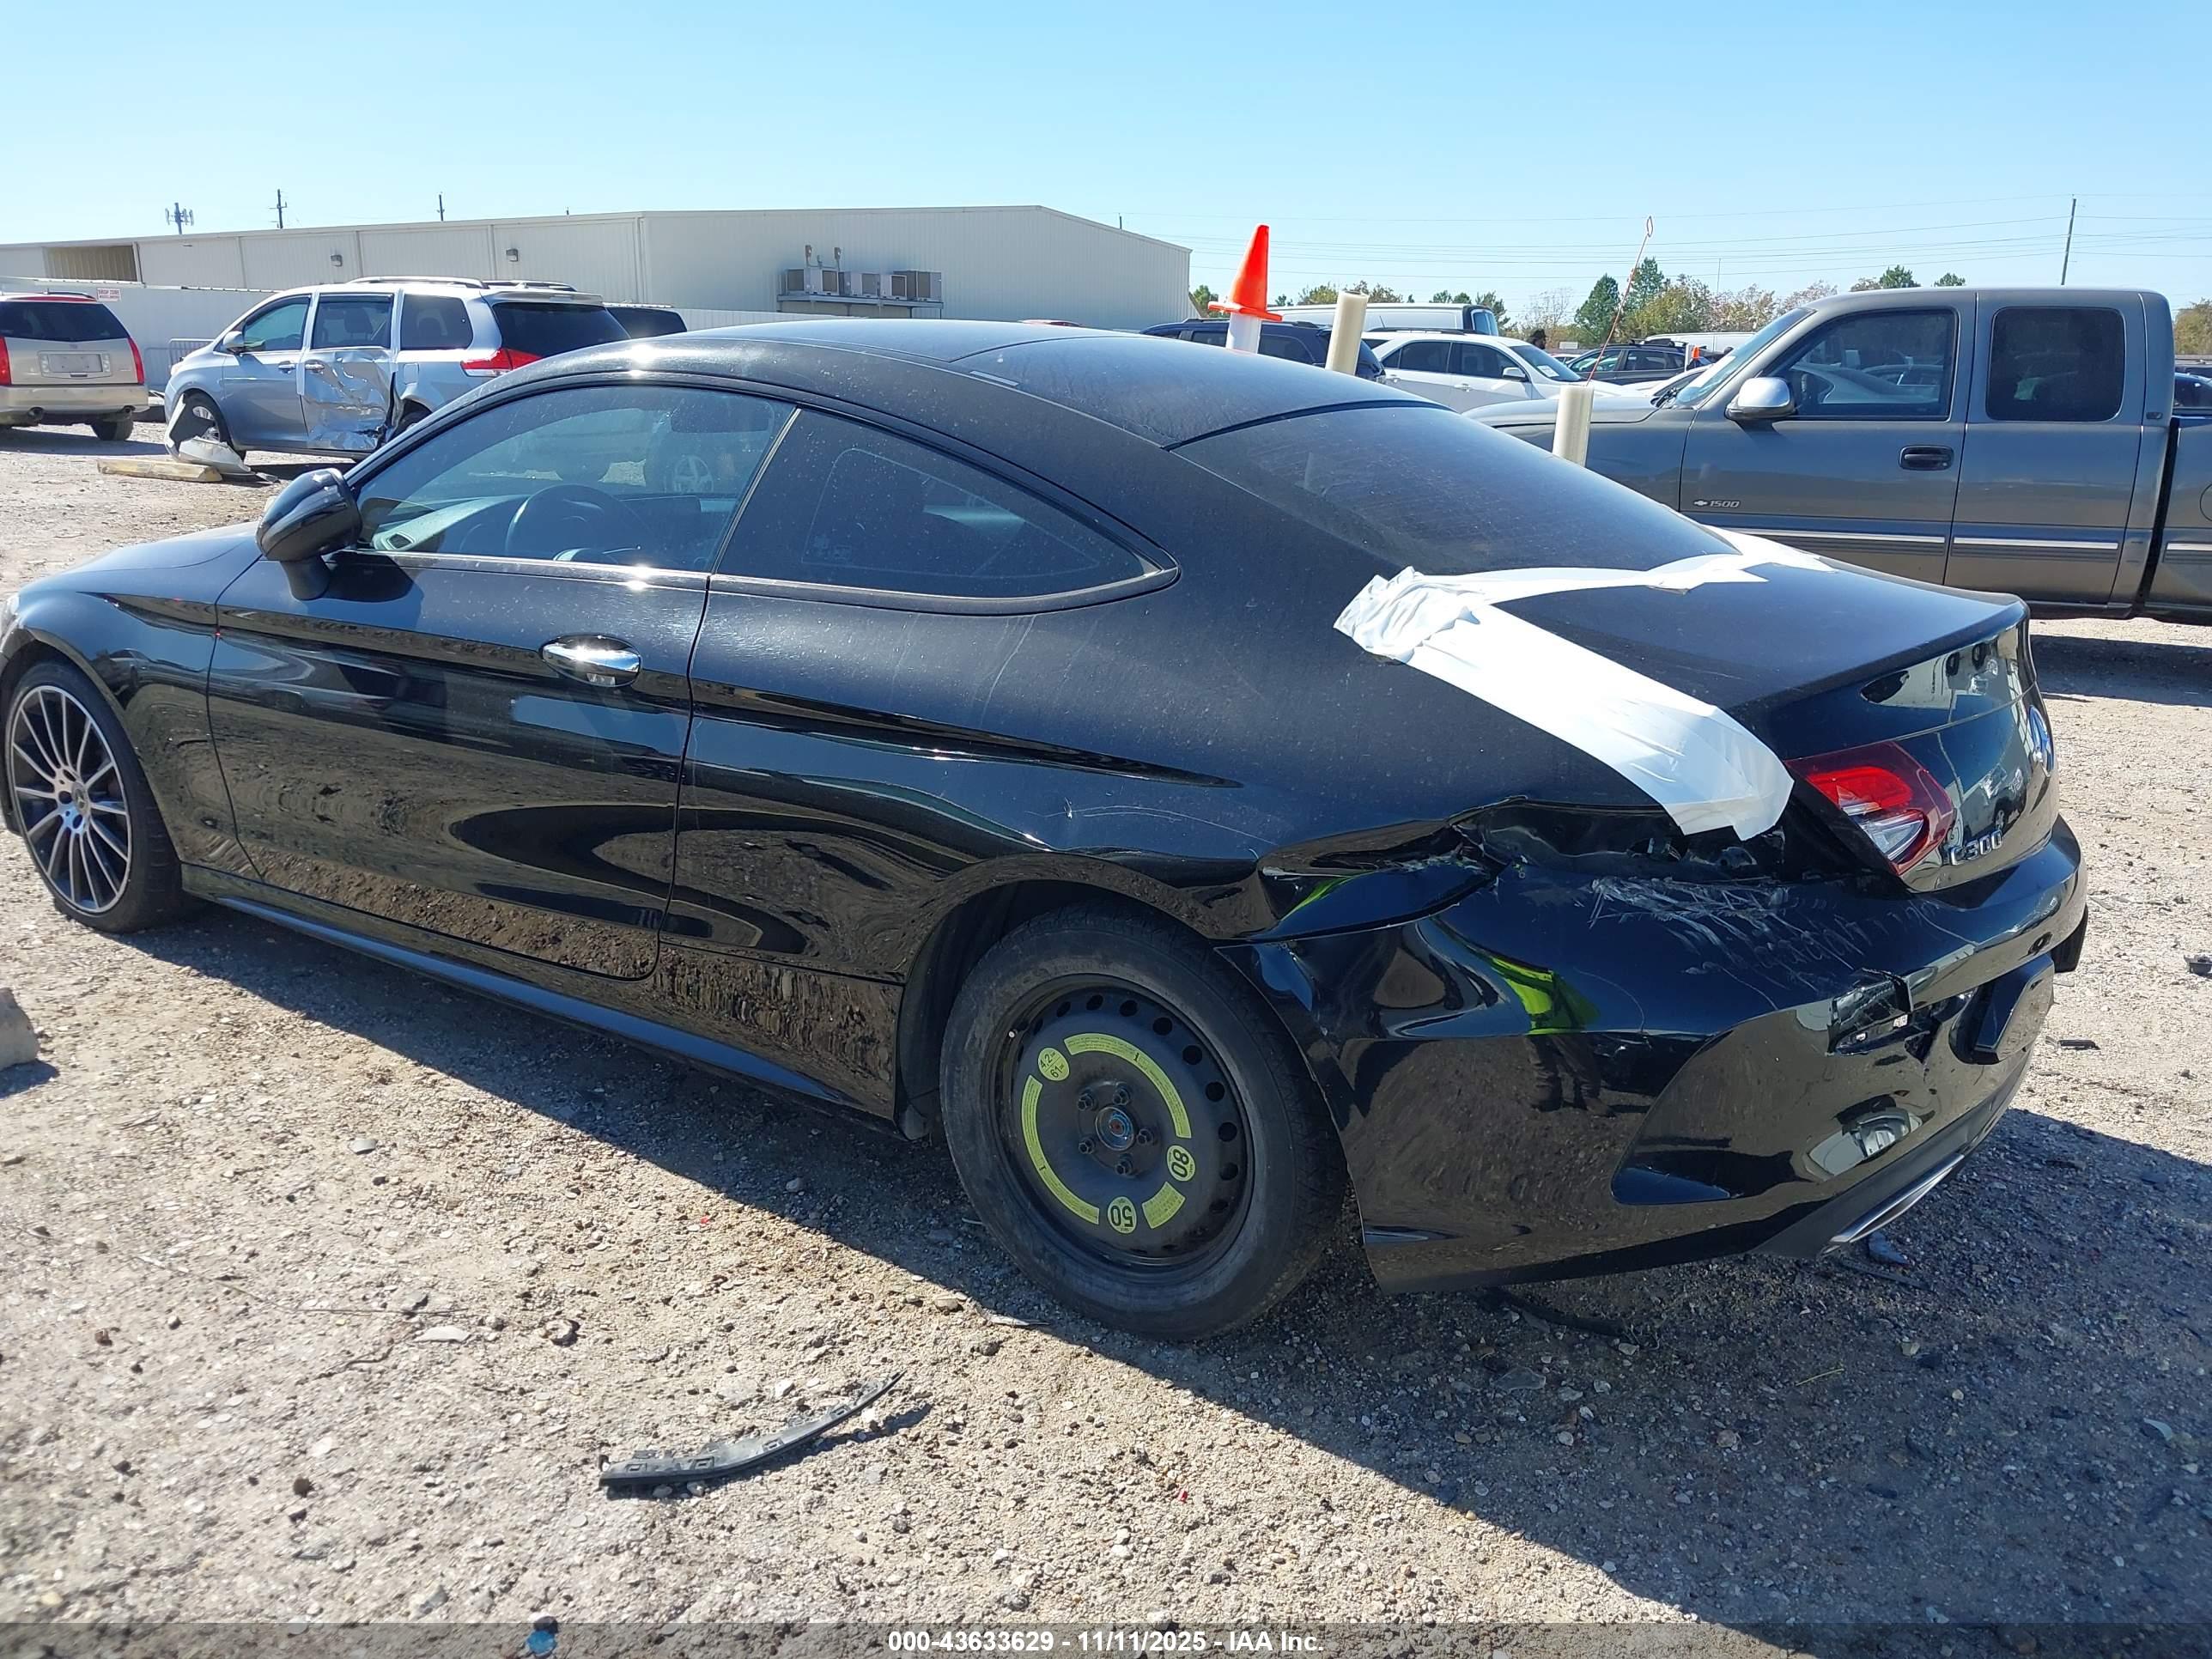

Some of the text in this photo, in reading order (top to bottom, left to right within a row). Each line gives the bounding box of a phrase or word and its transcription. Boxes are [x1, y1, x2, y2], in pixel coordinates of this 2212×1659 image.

[1050, 1066, 1063, 1078] 61
[1171, 1149, 1189, 1178] 80
[1110, 1205, 1133, 1227] 50
